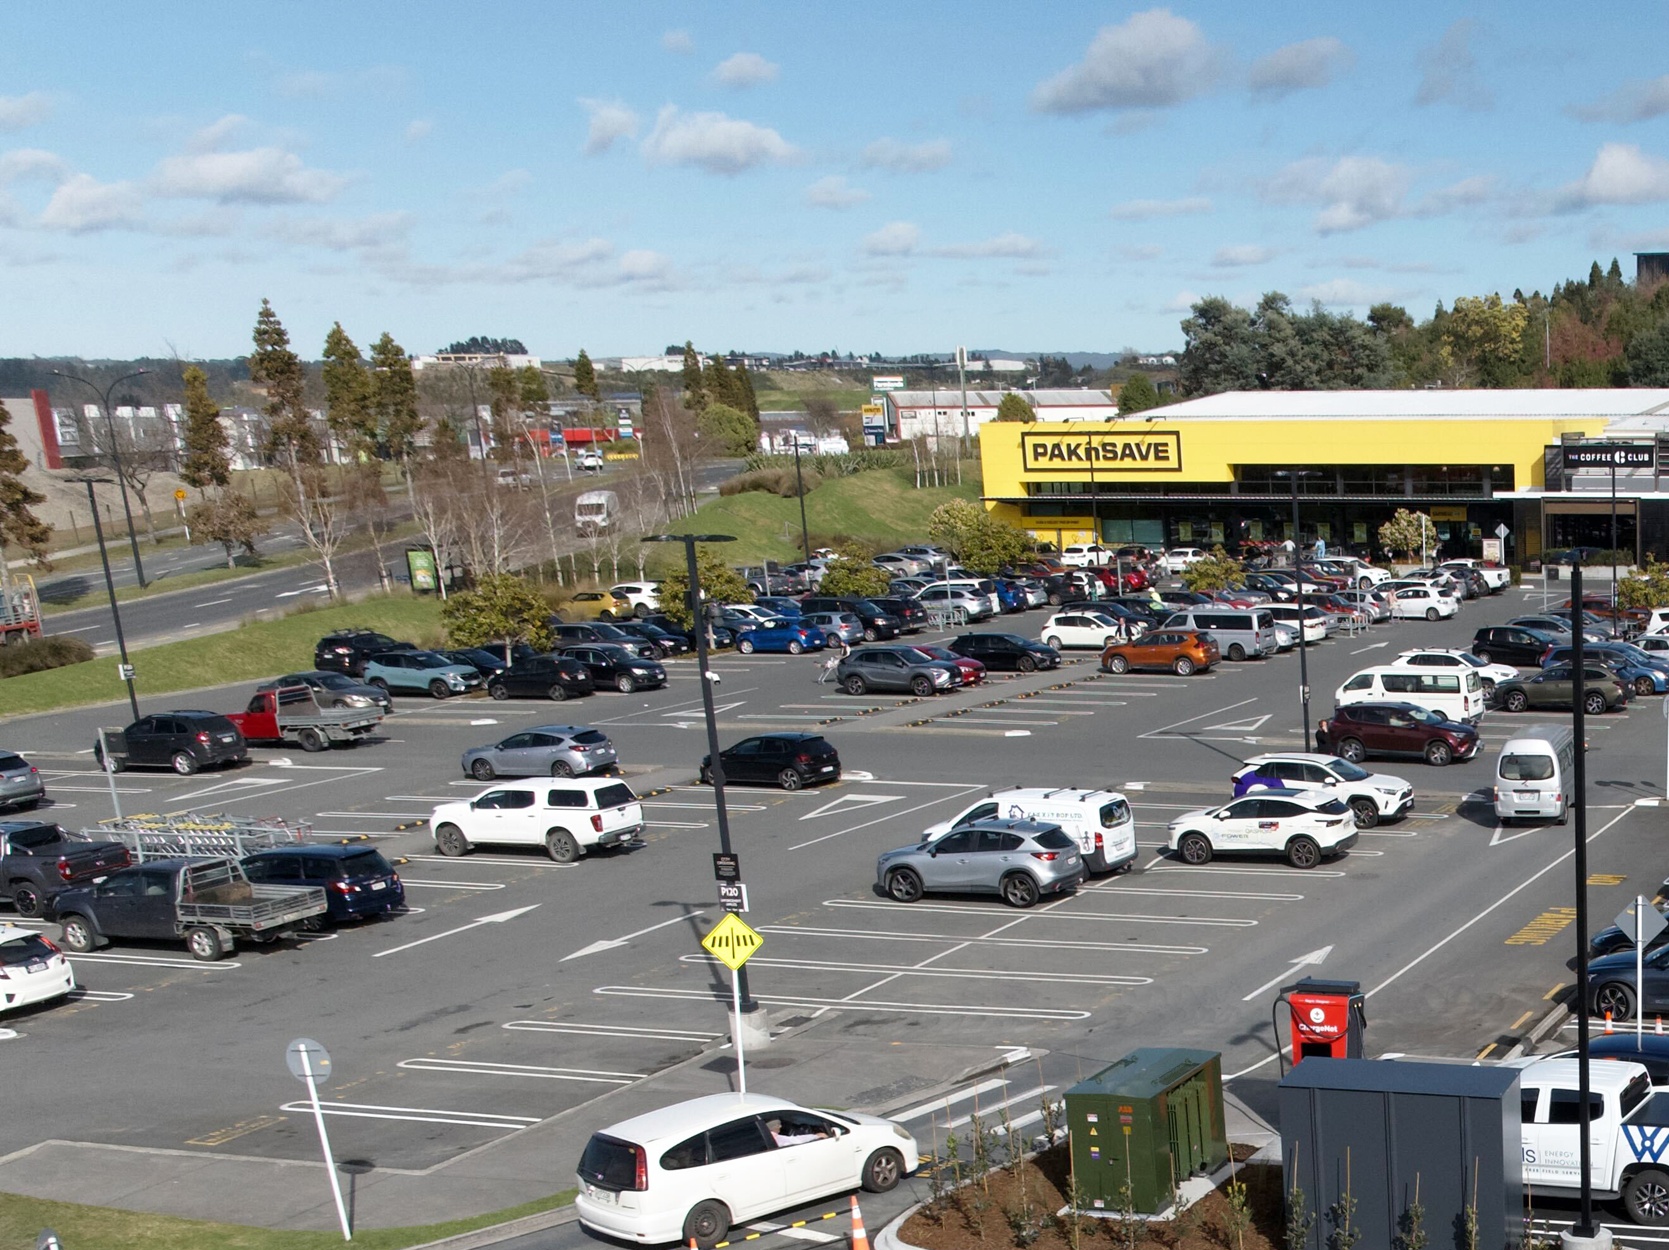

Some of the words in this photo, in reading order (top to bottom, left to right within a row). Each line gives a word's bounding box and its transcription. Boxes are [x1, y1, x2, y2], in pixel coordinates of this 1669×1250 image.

[1580, 453, 1611, 462] COFFEE
[1627, 453, 1649, 461] CLUB
[721, 887, 739, 897] P120
[1544, 1150, 1575, 1159] ENERGY
